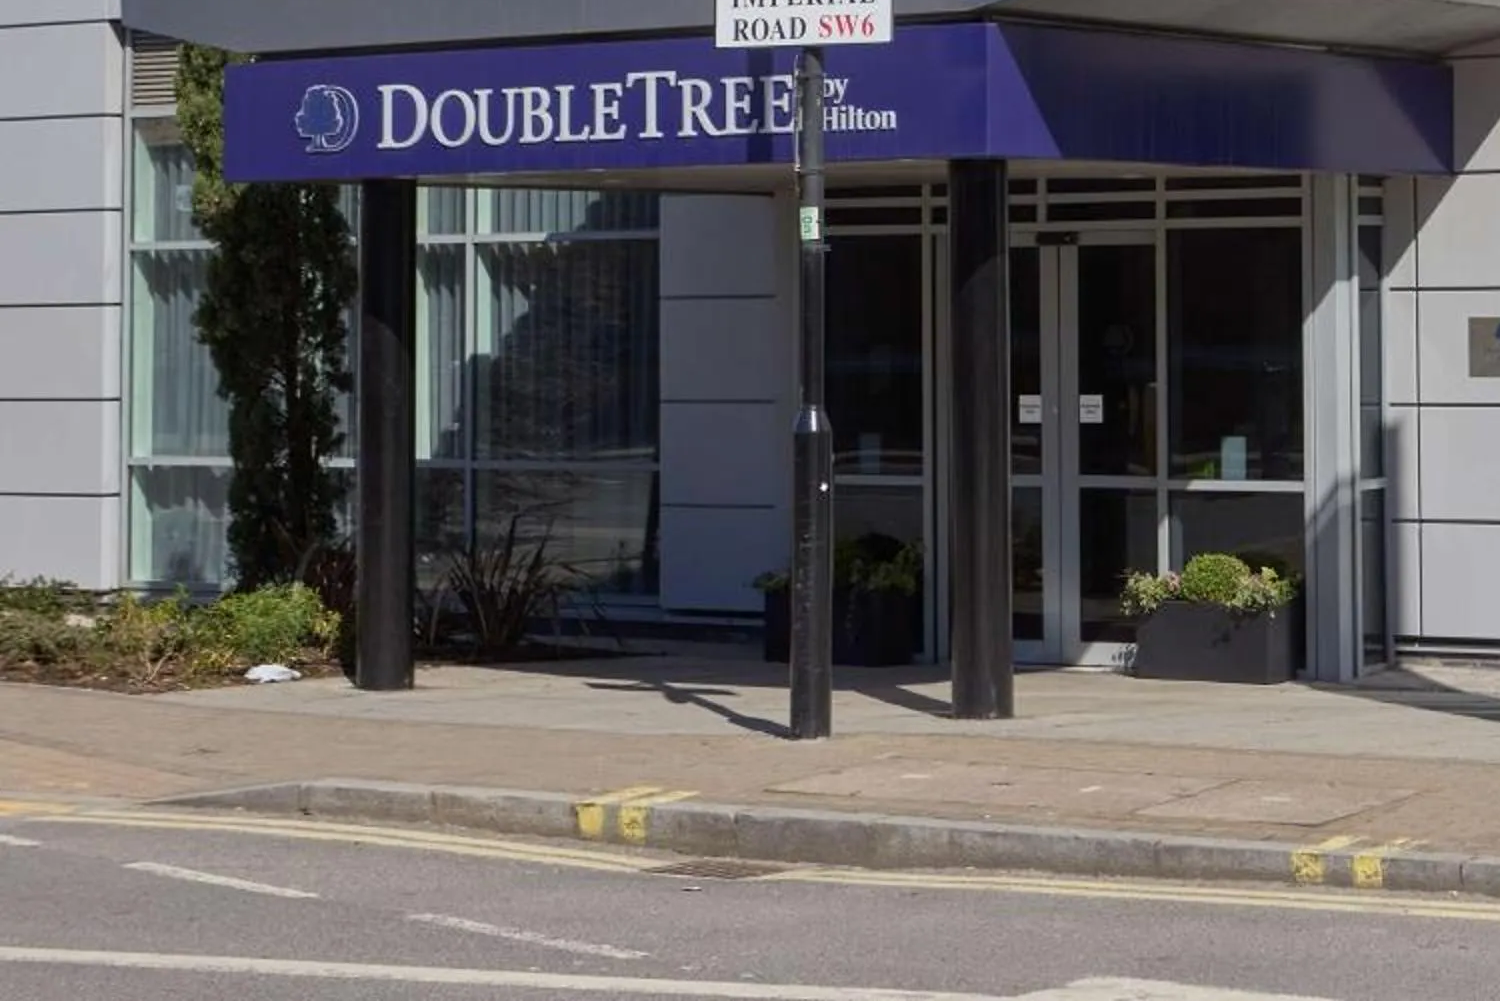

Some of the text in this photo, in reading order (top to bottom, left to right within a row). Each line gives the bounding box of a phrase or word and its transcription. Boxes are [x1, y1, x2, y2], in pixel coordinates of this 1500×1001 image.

[733, 13, 875, 42] ROAD SW6
[376, 70, 795, 151] DOUBLETREE
[822, 104, 897, 132] Hilton
